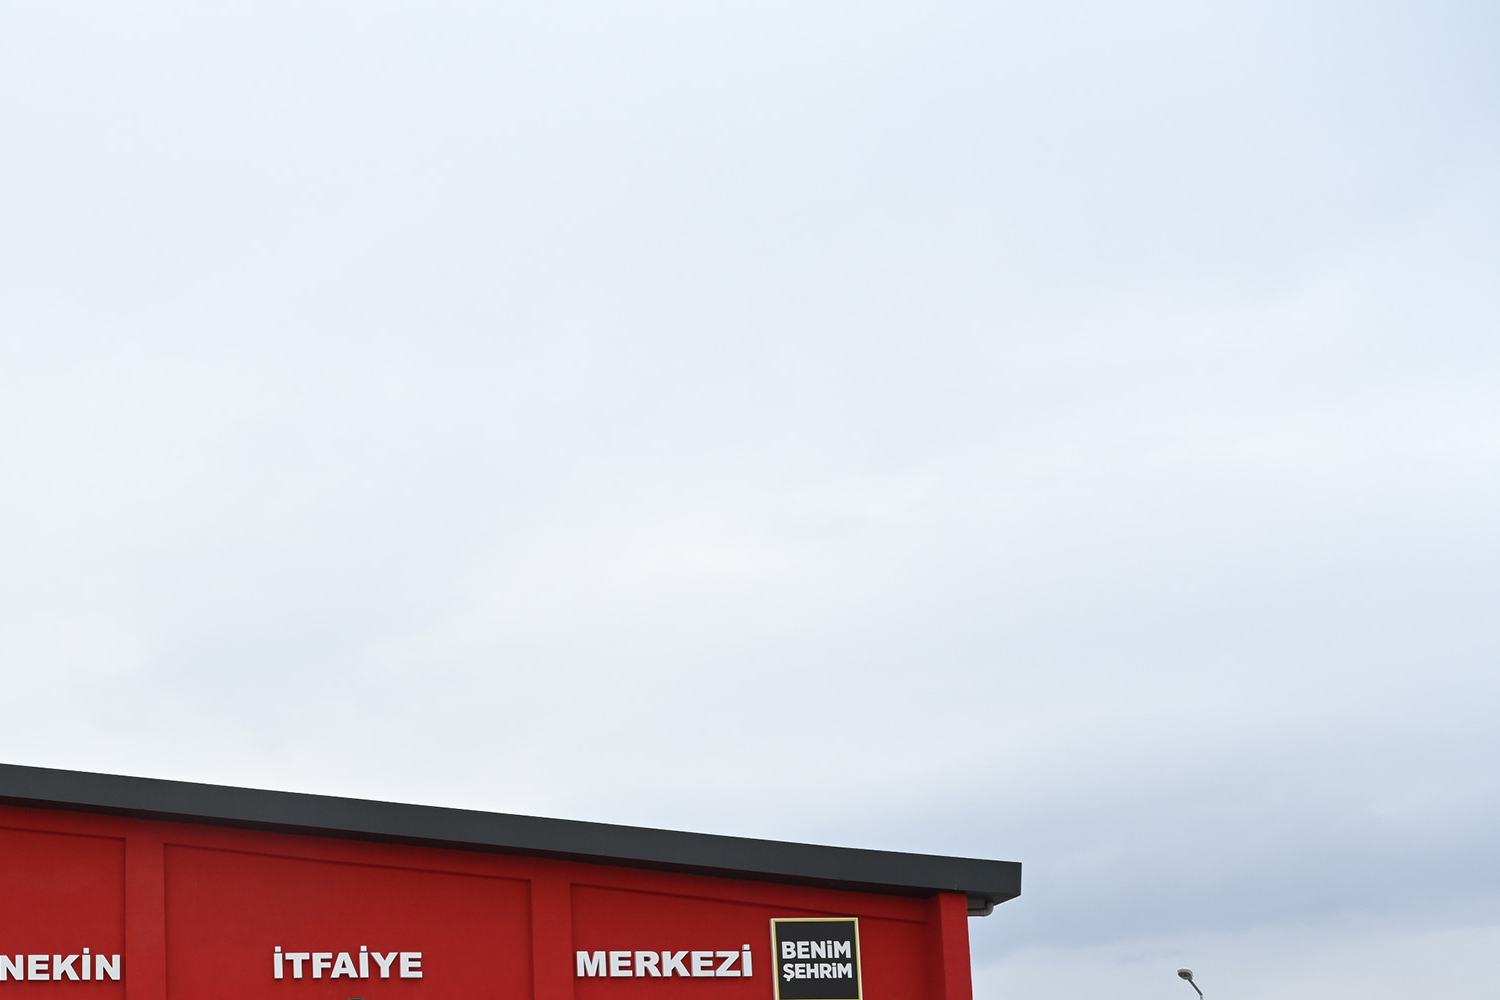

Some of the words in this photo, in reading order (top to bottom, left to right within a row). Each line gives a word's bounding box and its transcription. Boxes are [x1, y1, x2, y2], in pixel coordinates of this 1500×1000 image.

[274, 945, 423, 979] İTFAİYE
[576, 944, 753, 977] MERKEZİ
[781, 940, 852, 960] BENİM
[782, 963, 853, 982] ŞEHRİM
